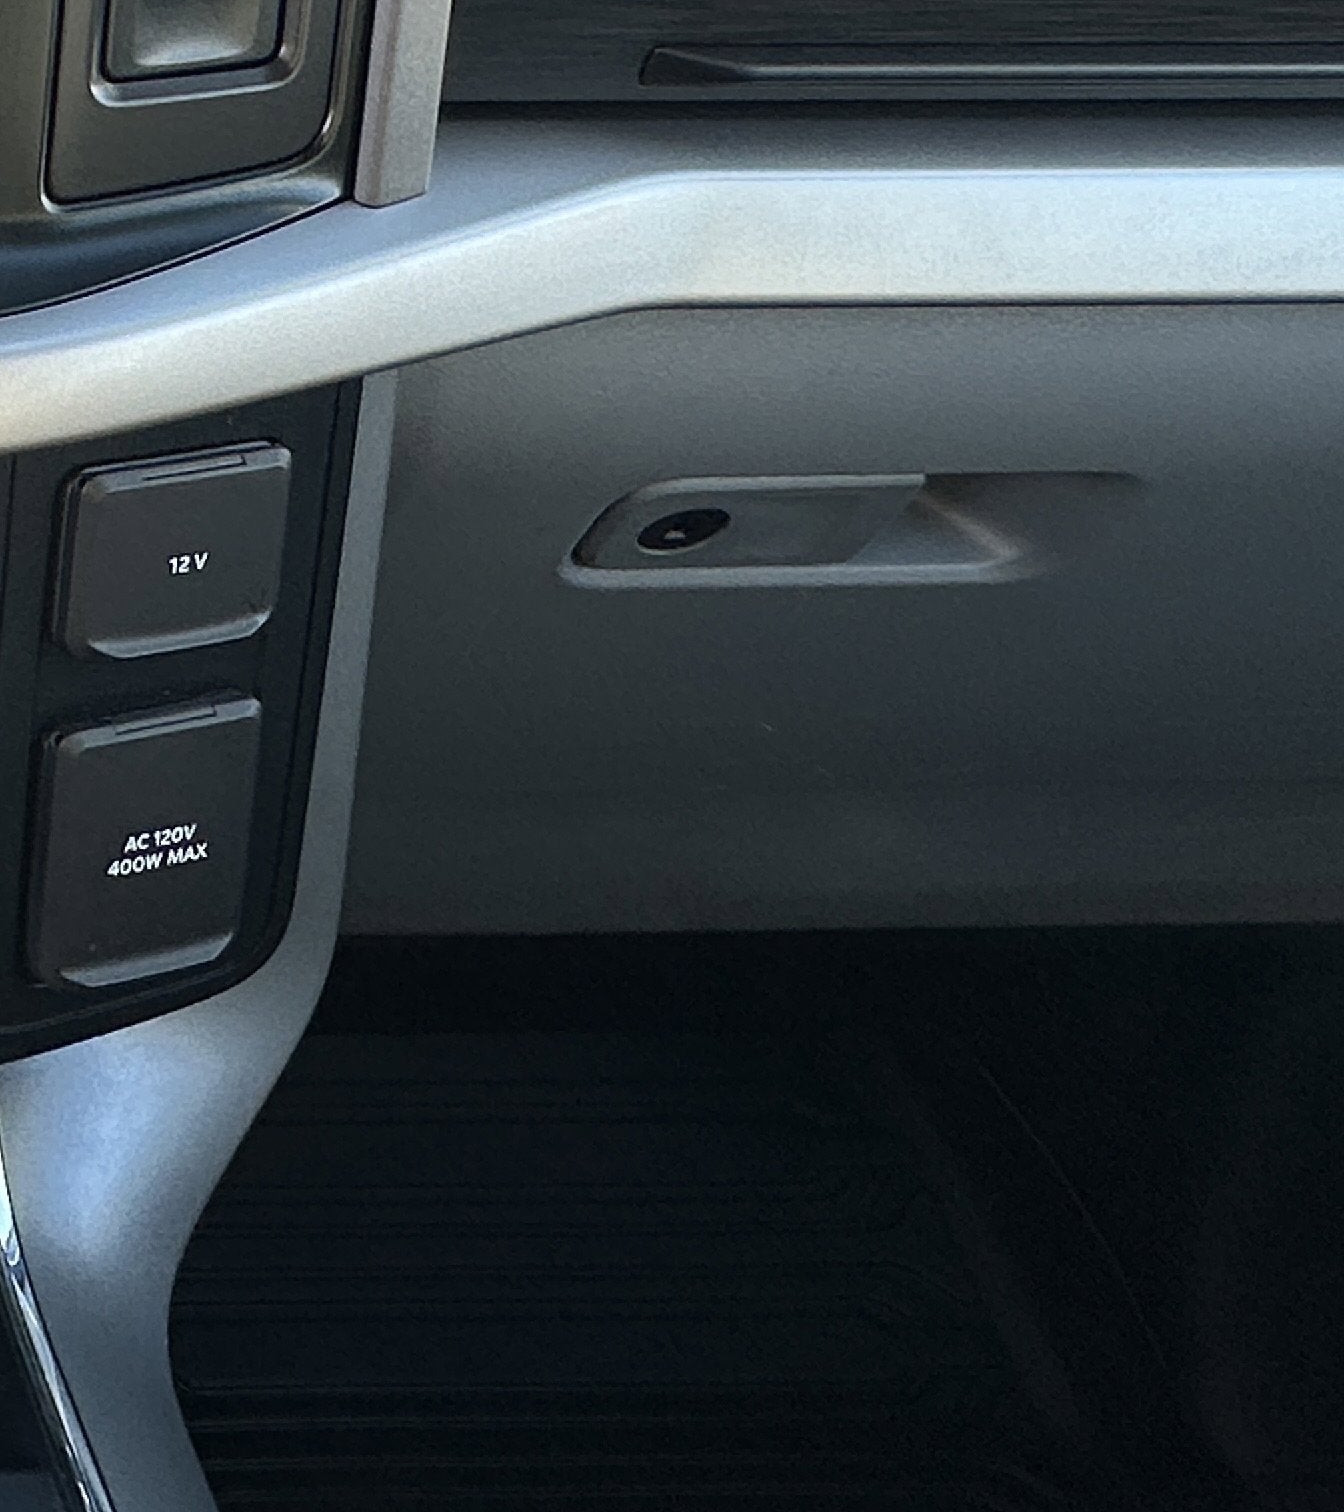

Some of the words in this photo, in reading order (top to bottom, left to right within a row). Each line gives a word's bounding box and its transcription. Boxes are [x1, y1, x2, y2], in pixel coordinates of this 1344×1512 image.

[168, 554, 191, 574] 12
[123, 833, 150, 855] AC
[152, 823, 198, 848] 120V
[106, 851, 163, 877] 400W
[166, 841, 209, 867] MAX
